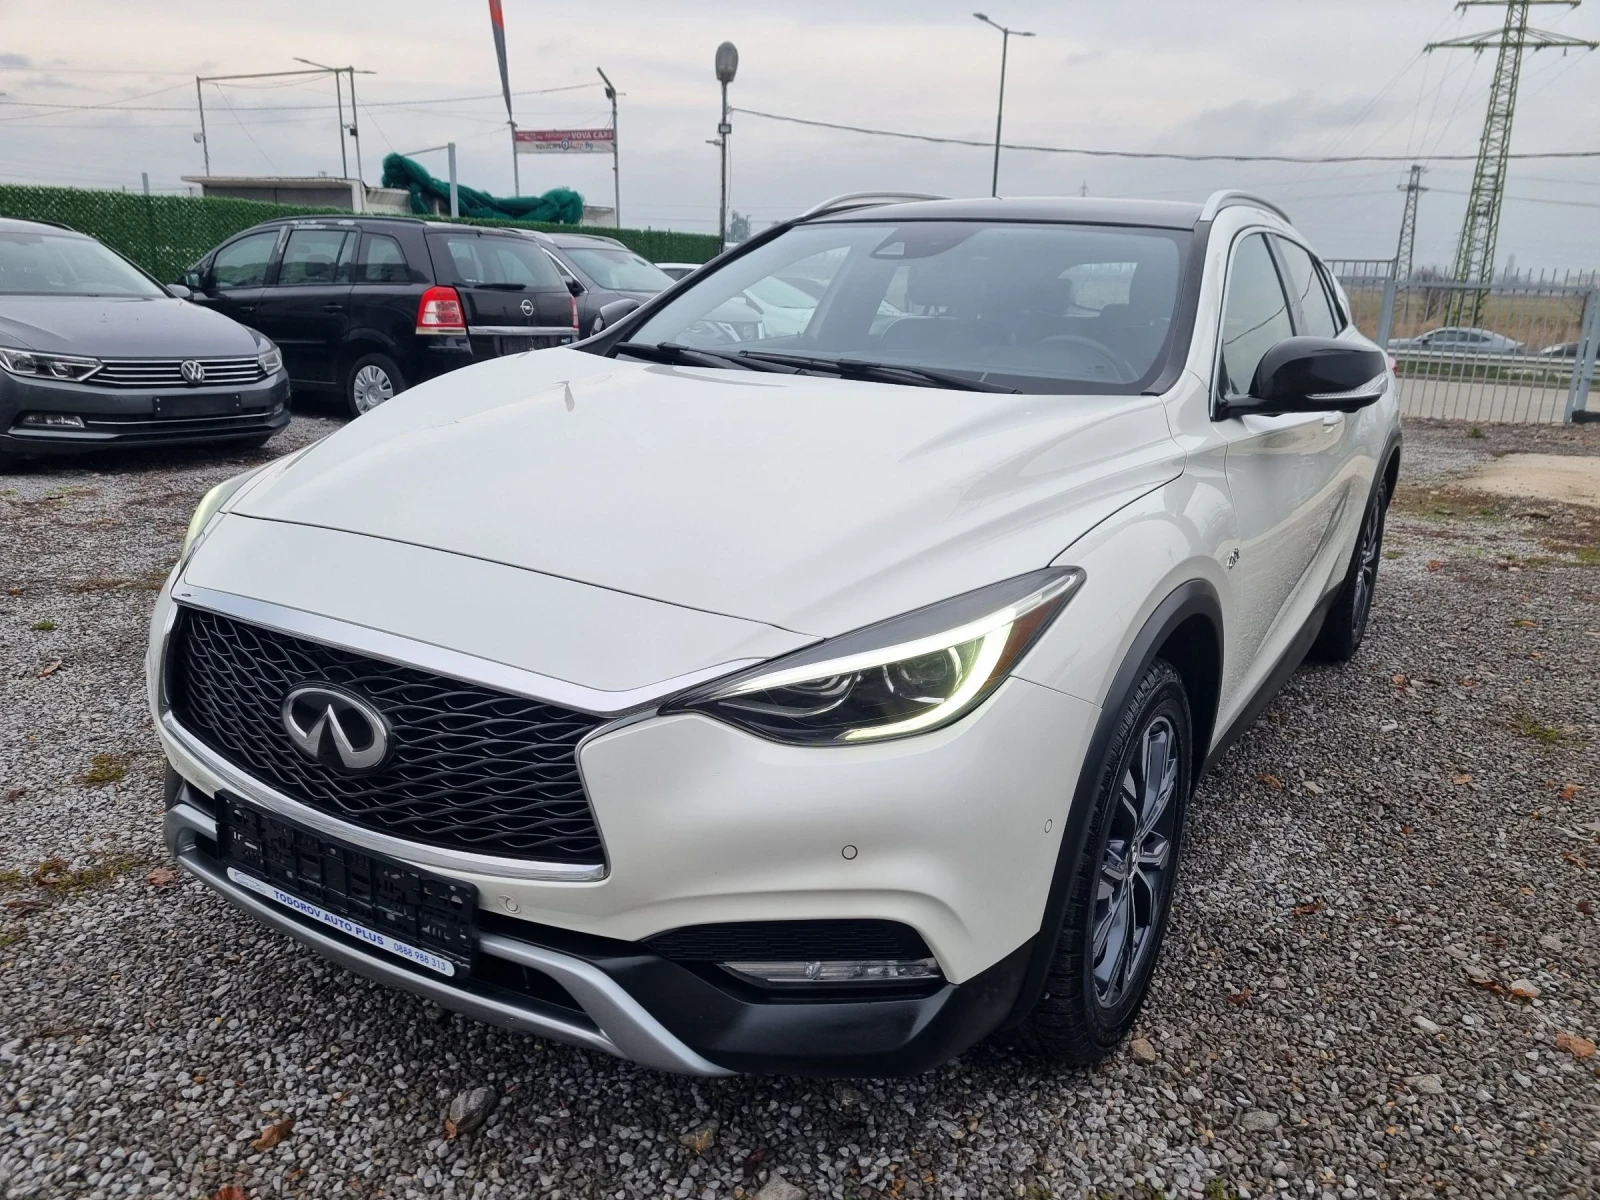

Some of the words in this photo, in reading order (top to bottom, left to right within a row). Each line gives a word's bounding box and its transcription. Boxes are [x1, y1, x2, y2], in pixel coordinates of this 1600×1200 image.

[571, 131, 591, 140] VOVA
[593, 131, 613, 139] CARS
[273, 889, 321, 918] TODOROV
[324, 913, 352, 932] AUTO
[355, 926, 385, 945] PLUS
[393, 943, 413, 958] 0888
[414, 950, 430, 965] 988
[431, 957, 447, 971] 313
